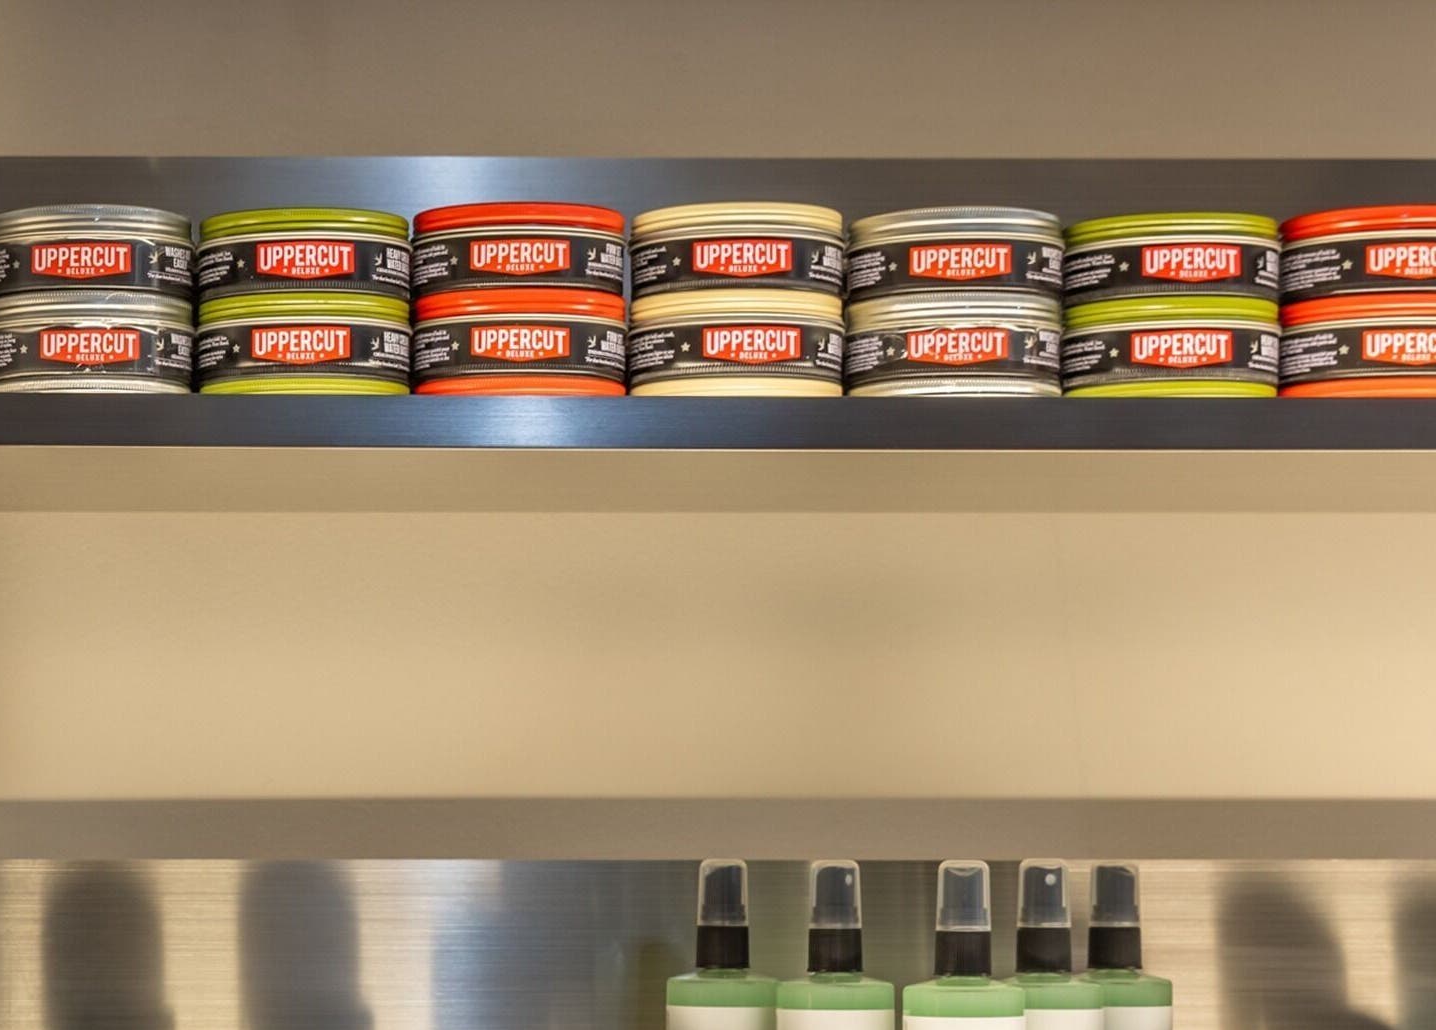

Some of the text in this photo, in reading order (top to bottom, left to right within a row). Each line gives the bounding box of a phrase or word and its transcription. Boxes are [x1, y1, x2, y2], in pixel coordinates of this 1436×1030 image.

[34, 247, 128, 271] UPPERCUT
[259, 245, 351, 270] UPPERCUT
[473, 243, 566, 267] UPPERCUT
[696, 243, 788, 268] UPPERCUT
[913, 247, 1008, 272] UPPERCUT
[1145, 247, 1237, 273] UPPERCUT
[43, 334, 136, 357] UPPERCUT
[254, 330, 347, 356] UPPERCUT
[474, 328, 566, 354] UPPERCUT
[706, 329, 797, 355] UPPERCUT
[910, 332, 1005, 358] UPPERCUT
[1134, 333, 1228, 359] UPPERCUT
